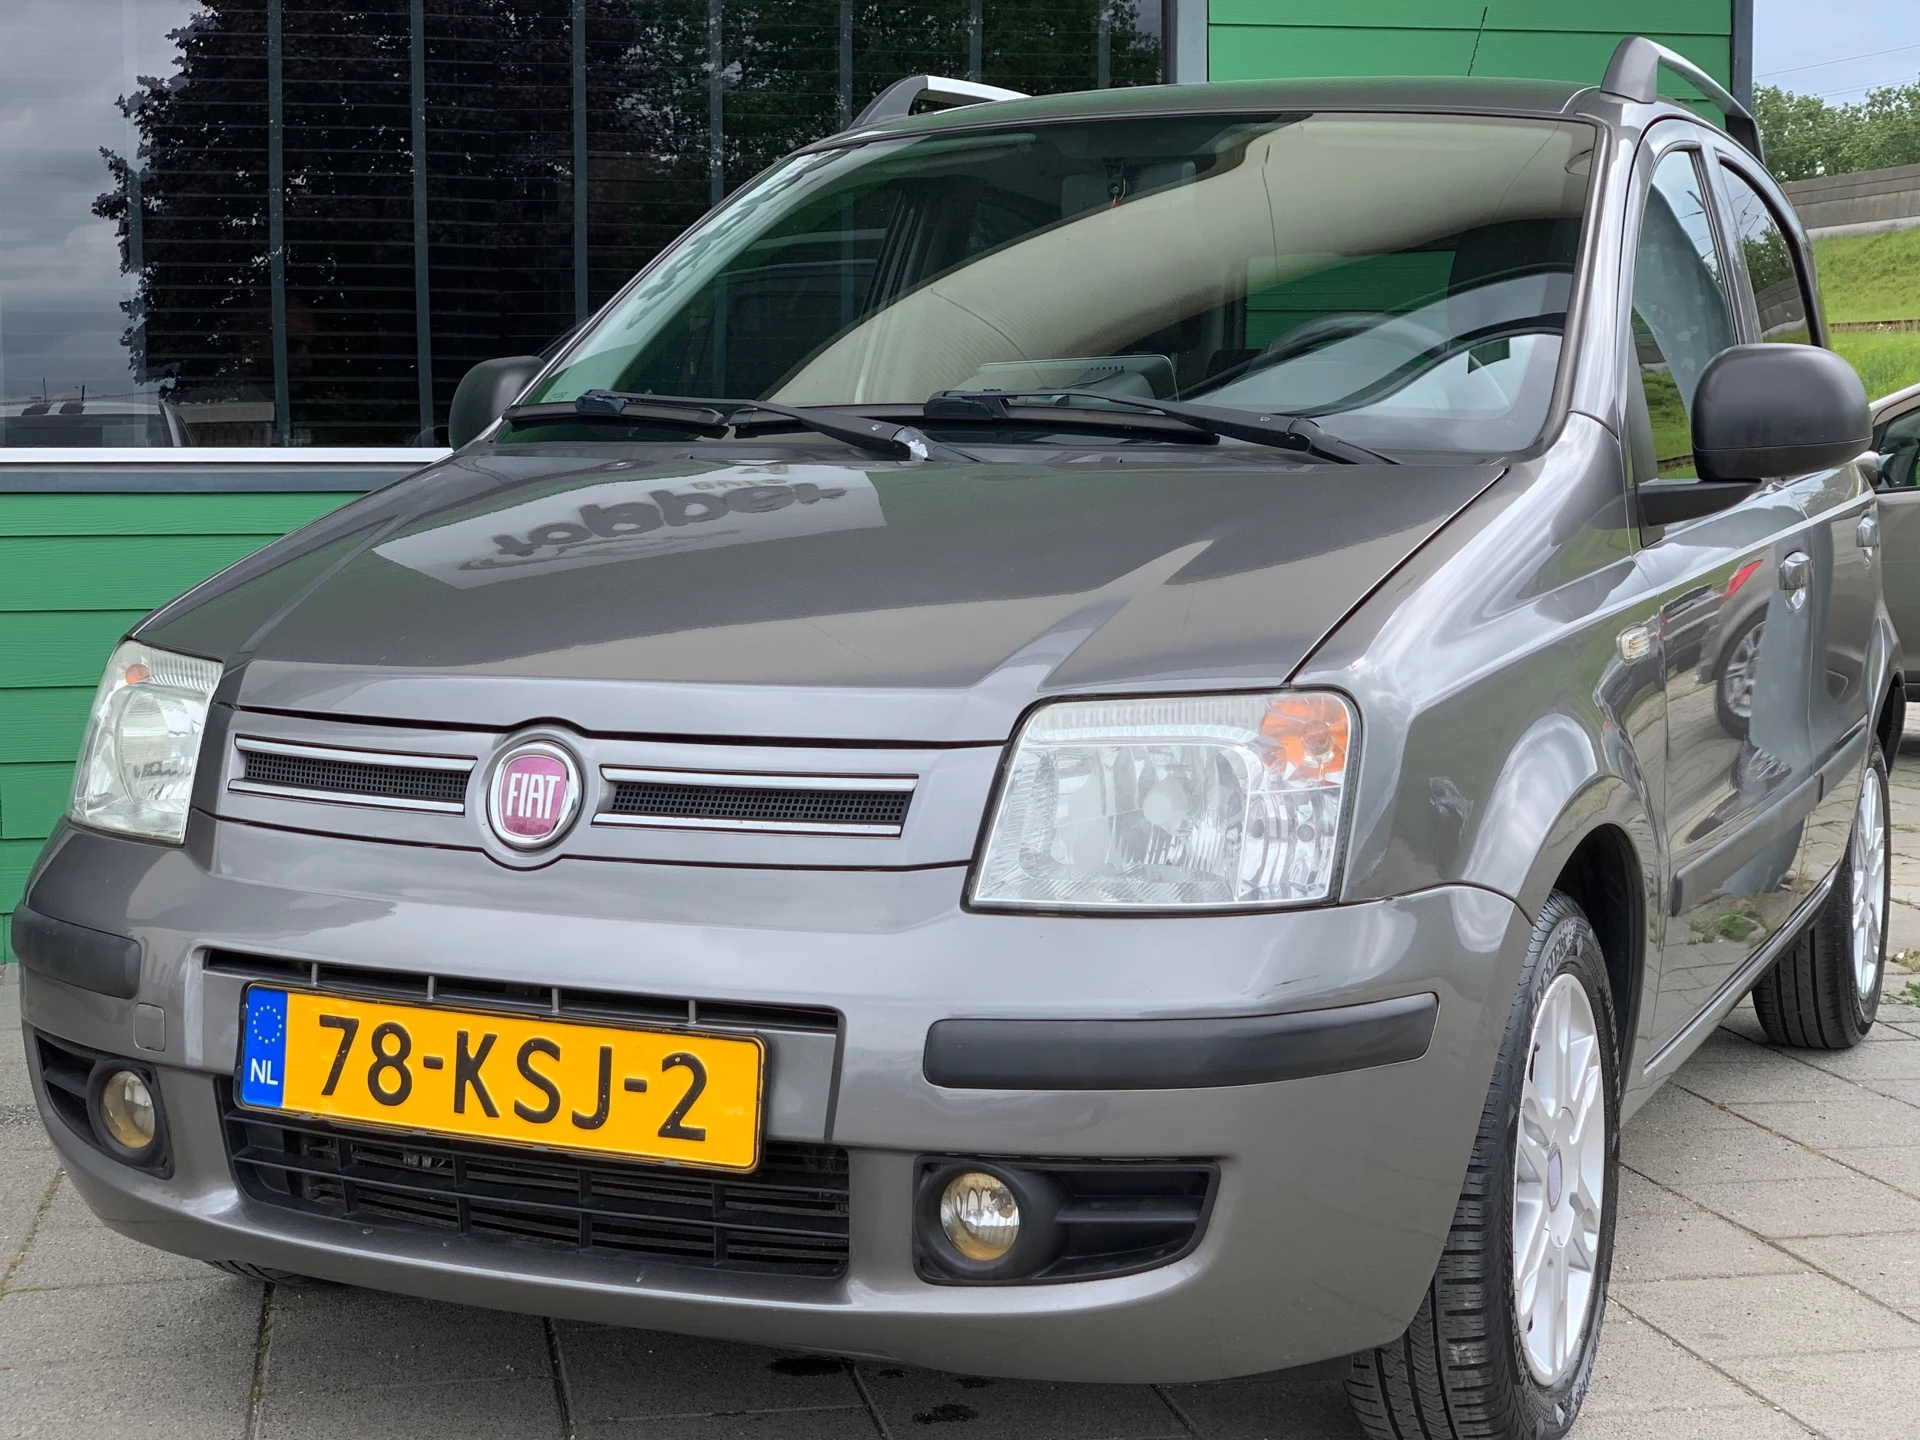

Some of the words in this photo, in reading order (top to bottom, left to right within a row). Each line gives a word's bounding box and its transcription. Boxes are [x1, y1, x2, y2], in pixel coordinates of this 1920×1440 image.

[506, 772, 561, 819] FIAT
[250, 1058, 279, 1087] NL
[318, 1014, 709, 1142] 78-KSJ-2
